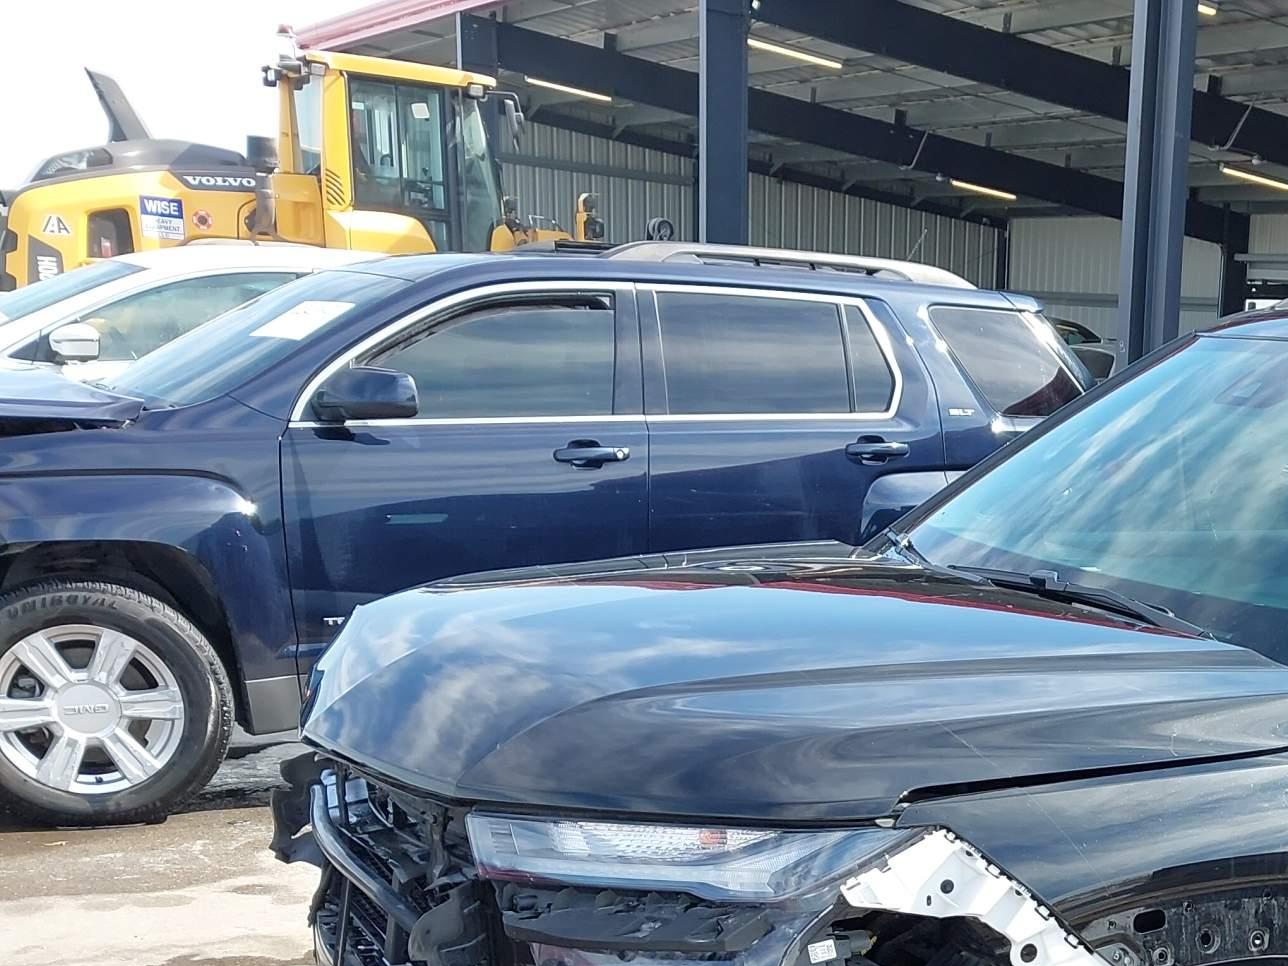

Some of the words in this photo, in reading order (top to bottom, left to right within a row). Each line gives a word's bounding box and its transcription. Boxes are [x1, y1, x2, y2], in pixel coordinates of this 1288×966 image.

[182, 175, 257, 187] VOLVO
[143, 198, 180, 216] WISE
[63, 703, 109, 716] GMC
